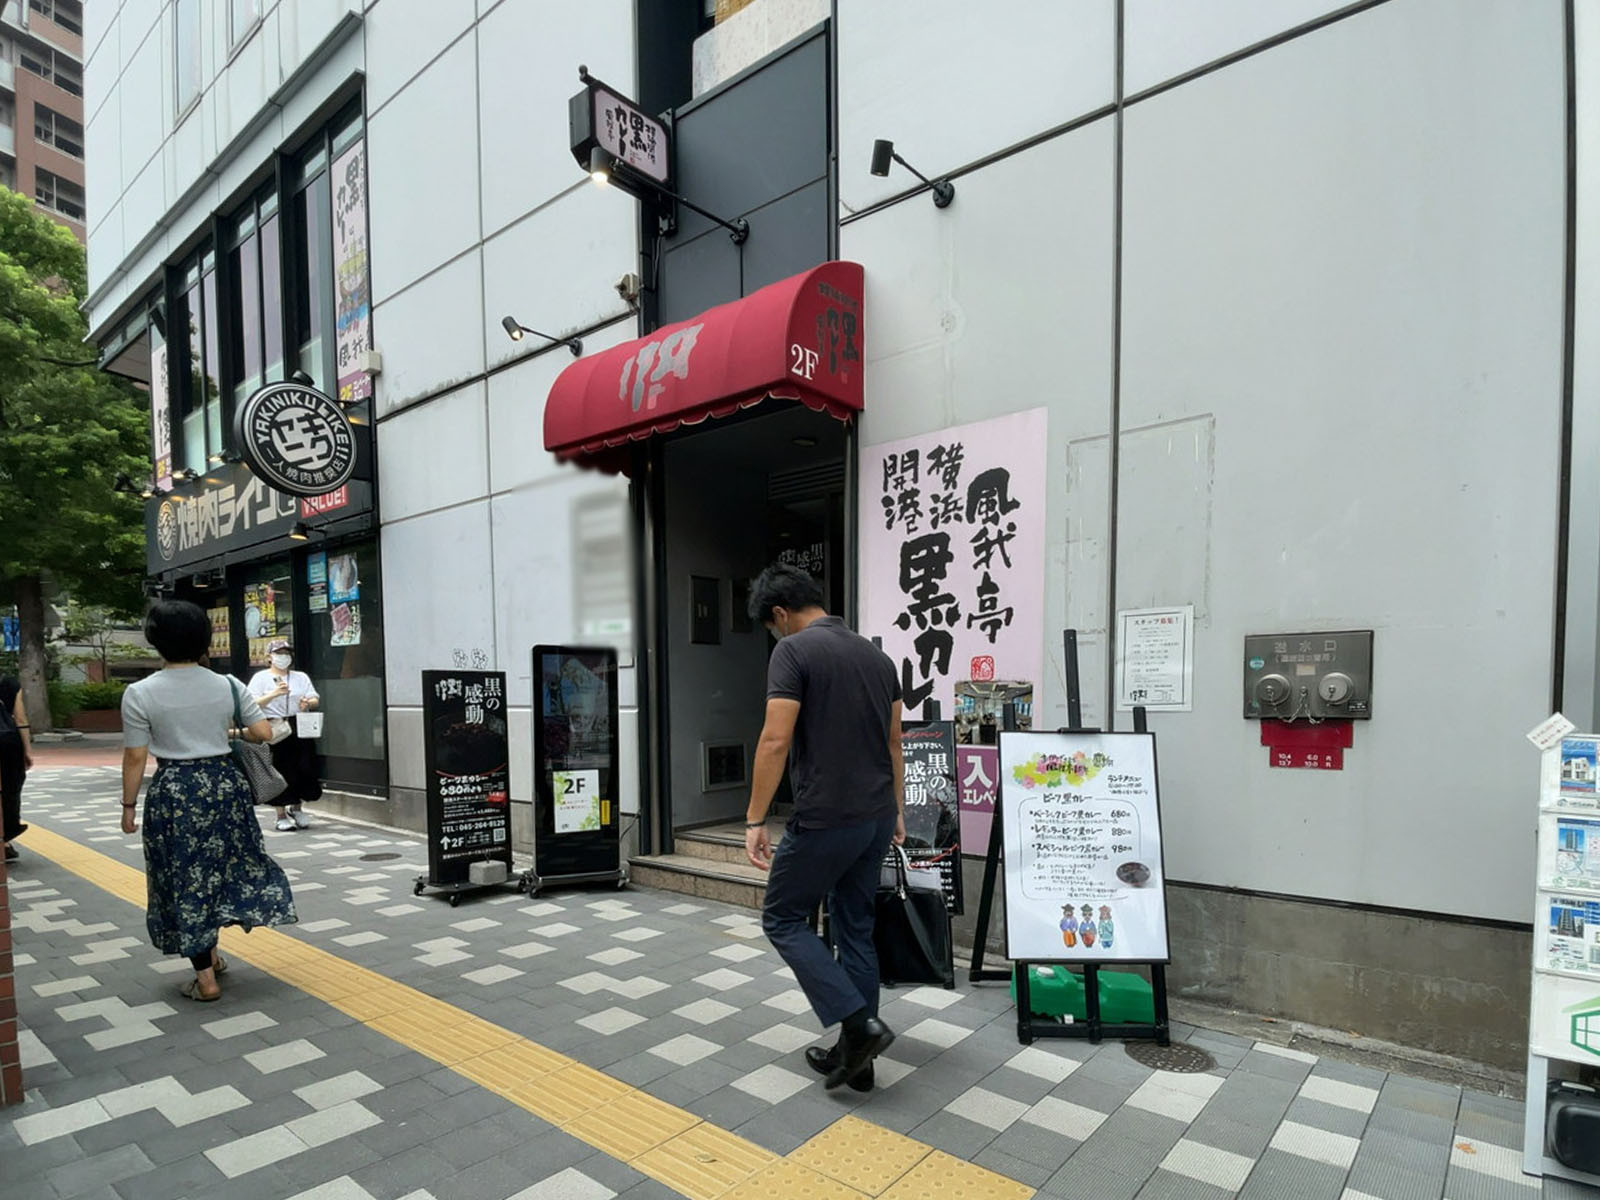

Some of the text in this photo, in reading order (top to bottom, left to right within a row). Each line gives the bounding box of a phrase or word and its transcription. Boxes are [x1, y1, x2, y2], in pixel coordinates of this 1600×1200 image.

[791, 344, 820, 381] 2F
[256, 391, 317, 444] YAKINIKU
[303, 485, 347, 514] VALUE!
[881, 449, 923, 534] 開港
[927, 442, 964, 530] 横浜
[966, 467, 1020, 644] 風我亭
[464, 683, 484, 724] 感動
[484, 677, 501, 710] 黒の
[564, 777, 586, 795] 2F
[904, 760, 927, 806] 感動
[928, 752, 949, 790] 黒の
[962, 789, 997, 805] エレベ
[451, 836, 465, 848] 2F
